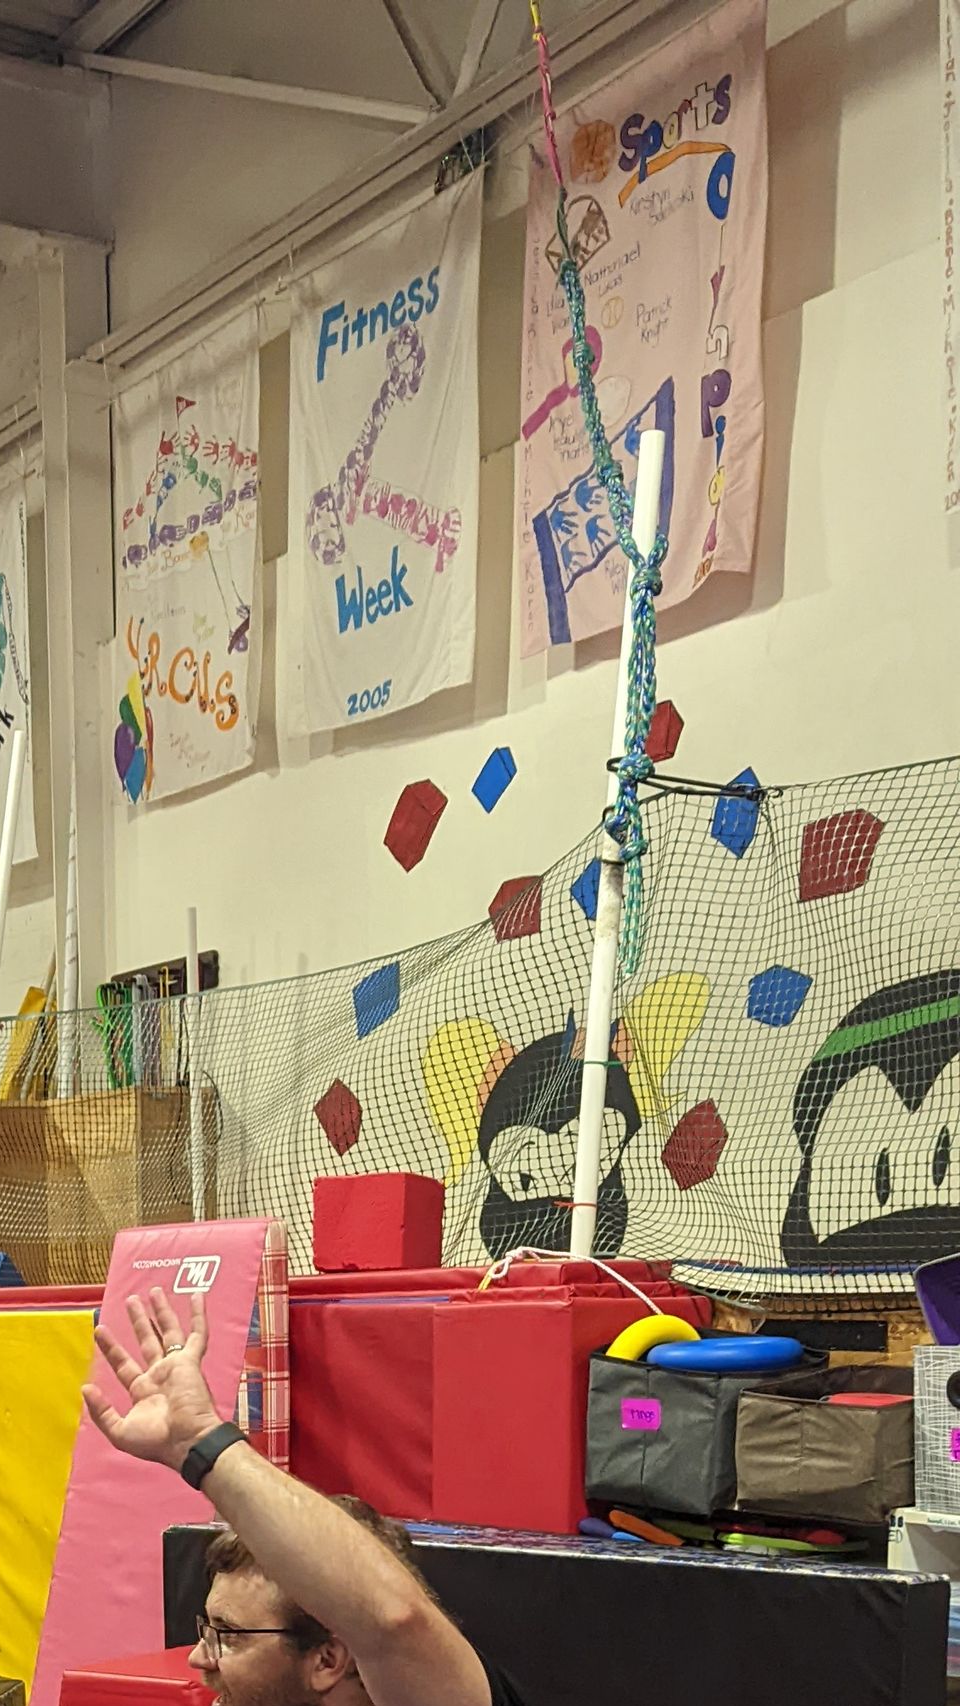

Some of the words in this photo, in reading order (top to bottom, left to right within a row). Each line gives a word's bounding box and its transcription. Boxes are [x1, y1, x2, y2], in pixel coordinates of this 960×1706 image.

[618, 73, 732, 184] Sports
[316, 266, 441, 382] Fitness
[335, 545, 414, 634] Week
[346, 679, 393, 716] 2005
